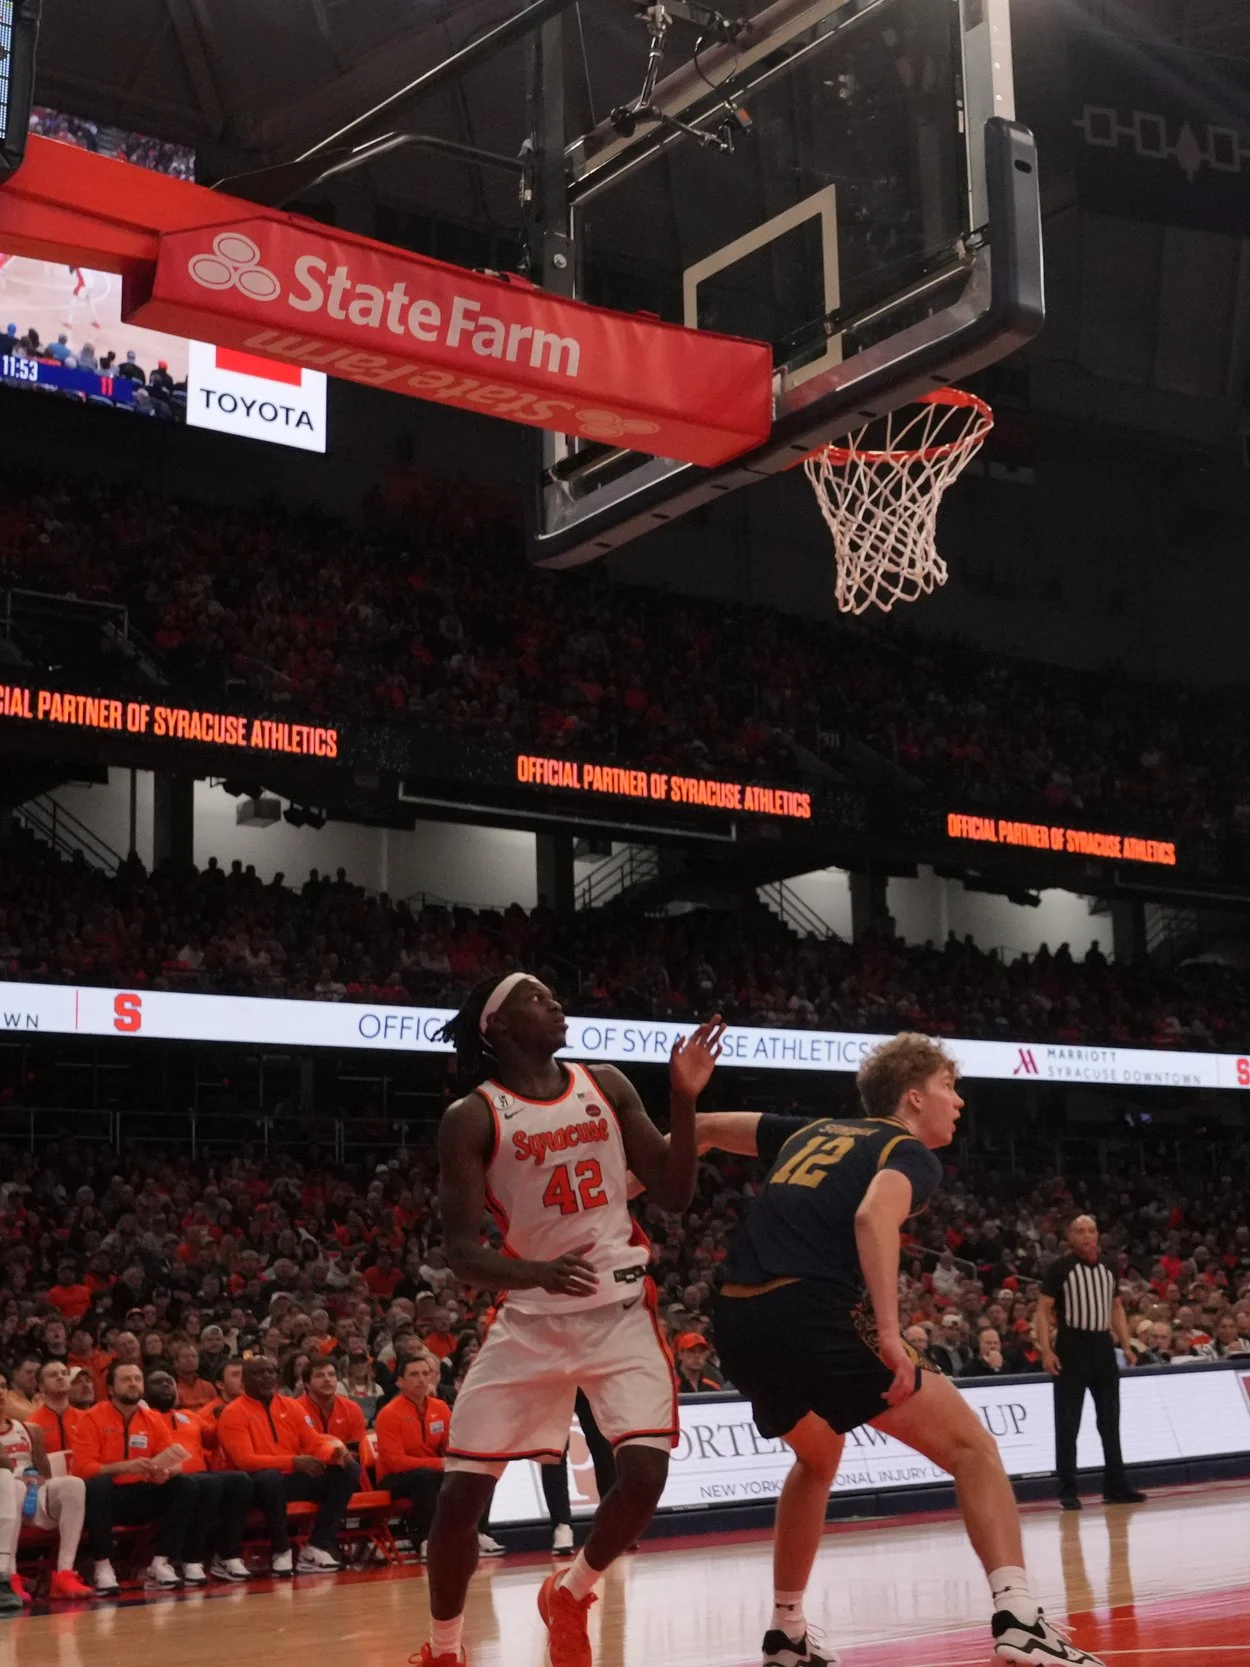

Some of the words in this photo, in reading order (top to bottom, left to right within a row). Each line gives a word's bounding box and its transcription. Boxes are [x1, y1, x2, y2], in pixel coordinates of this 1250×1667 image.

[2, 355, 39, 382] 11:53
[200, 388, 314, 433] TOYOTA
[38, 690, 122, 730] PARTNER
[127, 702, 150, 734] OF
[153, 705, 247, 748] SYRACUSE
[251, 719, 338, 759] ATHLETICS
[517, 754, 580, 788] OFFICIAL
[583, 764, 647, 798] PARTNER
[650, 773, 668, 800] OF
[671, 776, 742, 811] SYRACUSE
[744, 786, 811, 819] ATHLETICS
[947, 813, 997, 842] OFFICIAL
[998, 820, 1050, 849] PARTNER
[1050, 827, 1066, 851] OF
[1066, 829, 1122, 858] SYRACUSE
[1123, 837, 1176, 866] ATHLETICS
[113, 993, 142, 1032] S
[582, 1027, 616, 1052] OF
[622, 1028, 748, 1059] SYRASE
[1047, 1048, 1117, 1063] MARRIOTT
[1048, 1065, 1117, 1082] SYRACUSE
[1123, 1069, 1200, 1086] DOWNTOWN
[1236, 1058, 1250, 1086] S
[512, 1118, 609, 1166] Syracuse
[769, 1135, 855, 1188] 12
[542, 1158, 609, 1216] 42
[700, 1484, 736, 1499] NEW
[879, 1467, 928, 1482] INJURY
